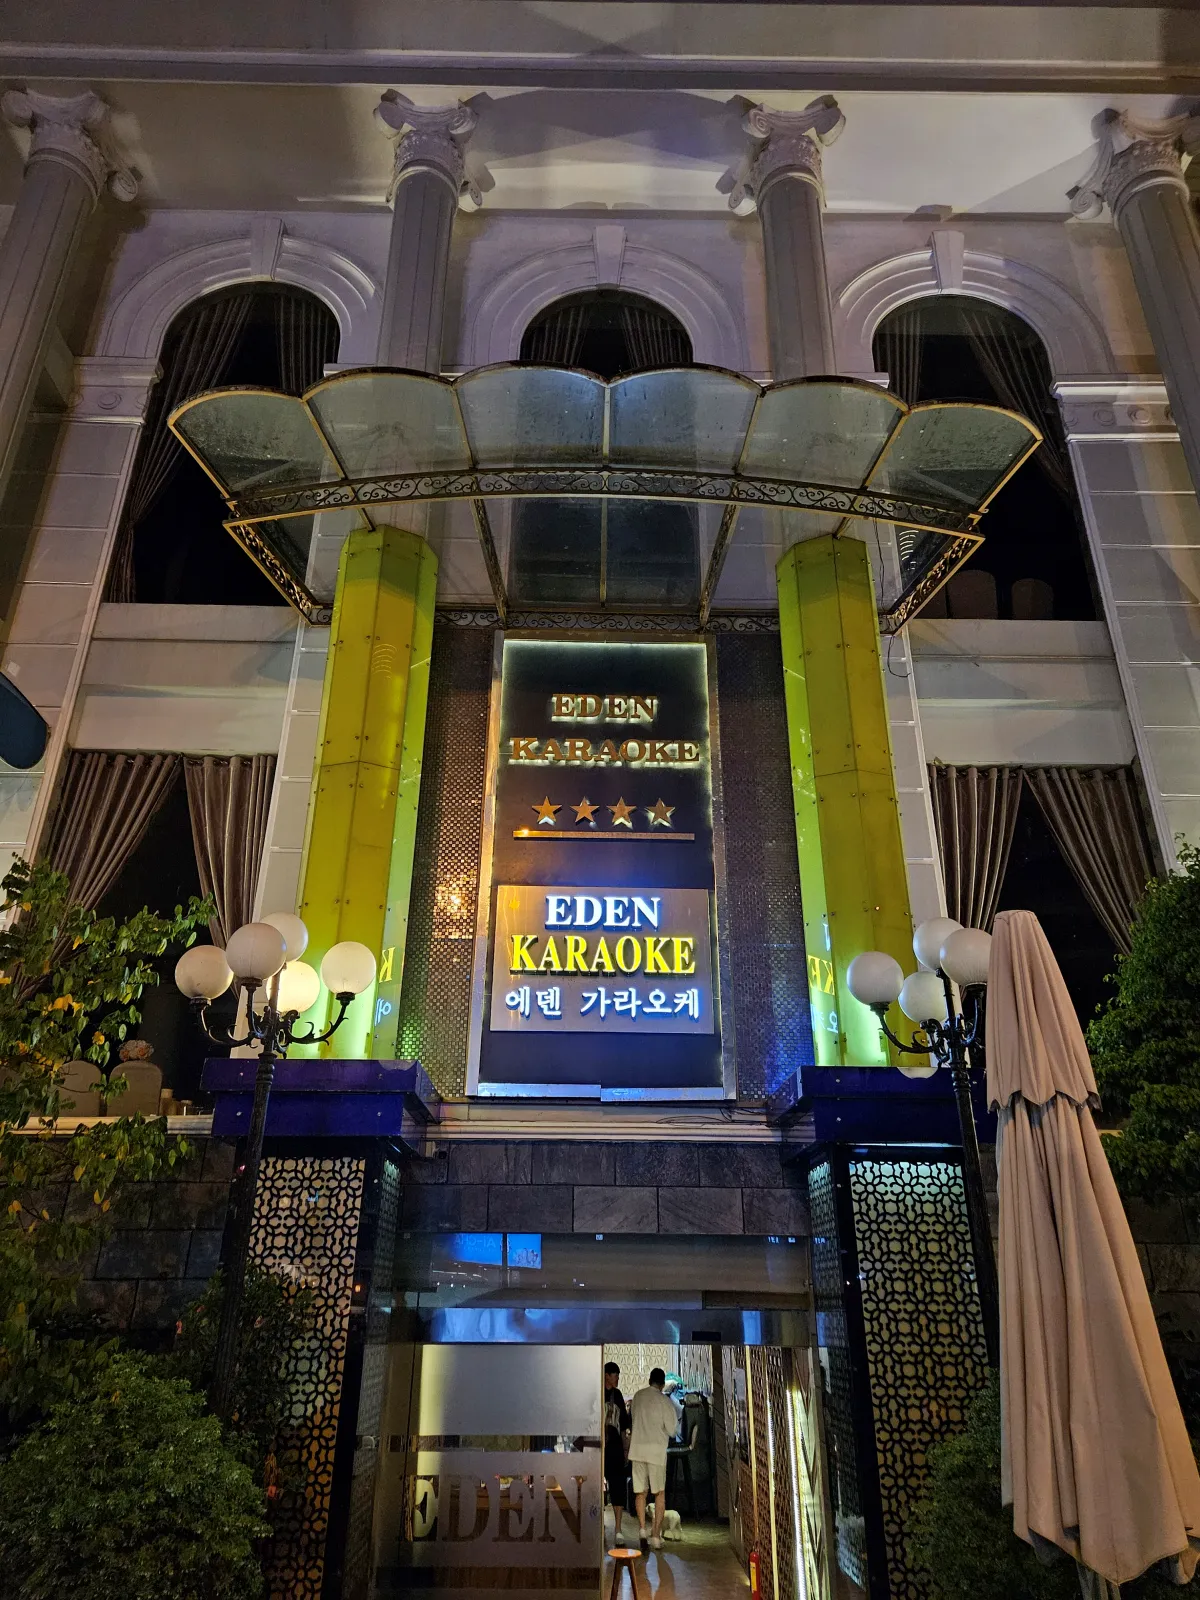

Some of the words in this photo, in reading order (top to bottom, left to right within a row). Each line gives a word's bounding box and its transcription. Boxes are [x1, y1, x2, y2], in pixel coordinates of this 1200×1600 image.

[551, 693, 658, 721] EDEN
[509, 737, 700, 765] KARAOKE
[545, 895, 661, 929] EDEN
[510, 935, 696, 976] KARAOKE
[505, 986, 562, 1019] 에덴
[579, 986, 700, 1020] 가라오케
[399, 1474, 588, 1544] EDEN
